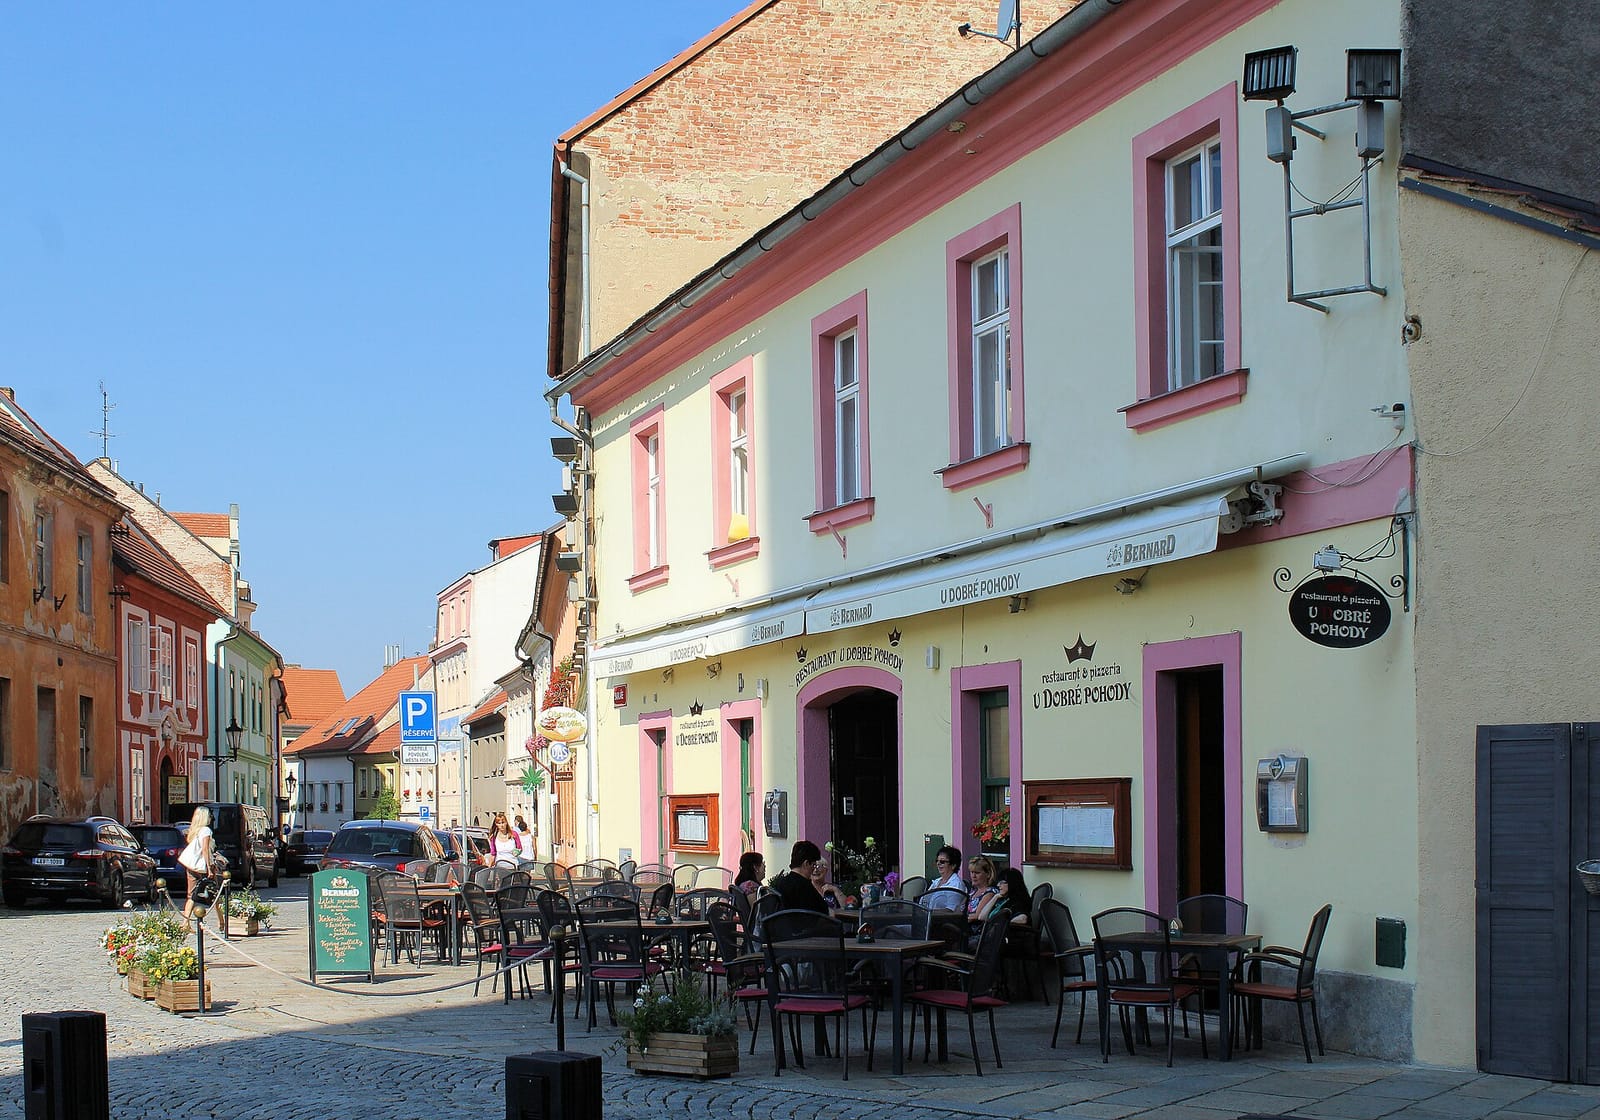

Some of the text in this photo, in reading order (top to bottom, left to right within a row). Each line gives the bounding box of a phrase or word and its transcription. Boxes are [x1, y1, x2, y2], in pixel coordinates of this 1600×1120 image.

[1123, 534, 1176, 565] BERNARD
[940, 572, 1021, 604] U DOBRÉ POHODY
[1300, 592, 1381, 606] restaurant & pizzeria
[840, 603, 873, 625] BERNARD
[1308, 606, 1318, 619] U
[760, 620, 785, 640] BERNARD
[1310, 622, 1369, 639] POHODY
[795, 644, 904, 687] RESTAURANT U DOBRÉ POHODY
[1042, 662, 1121, 684] restaurant & pizzeria
[1033, 682, 1132, 709] U DOBRÉ POHODY
[407, 697, 427, 727] P
[403, 728, 434, 737] RÉSERVÉ
[698, 730, 719, 745] POHODY
[321, 888, 360, 897] BERNARD
